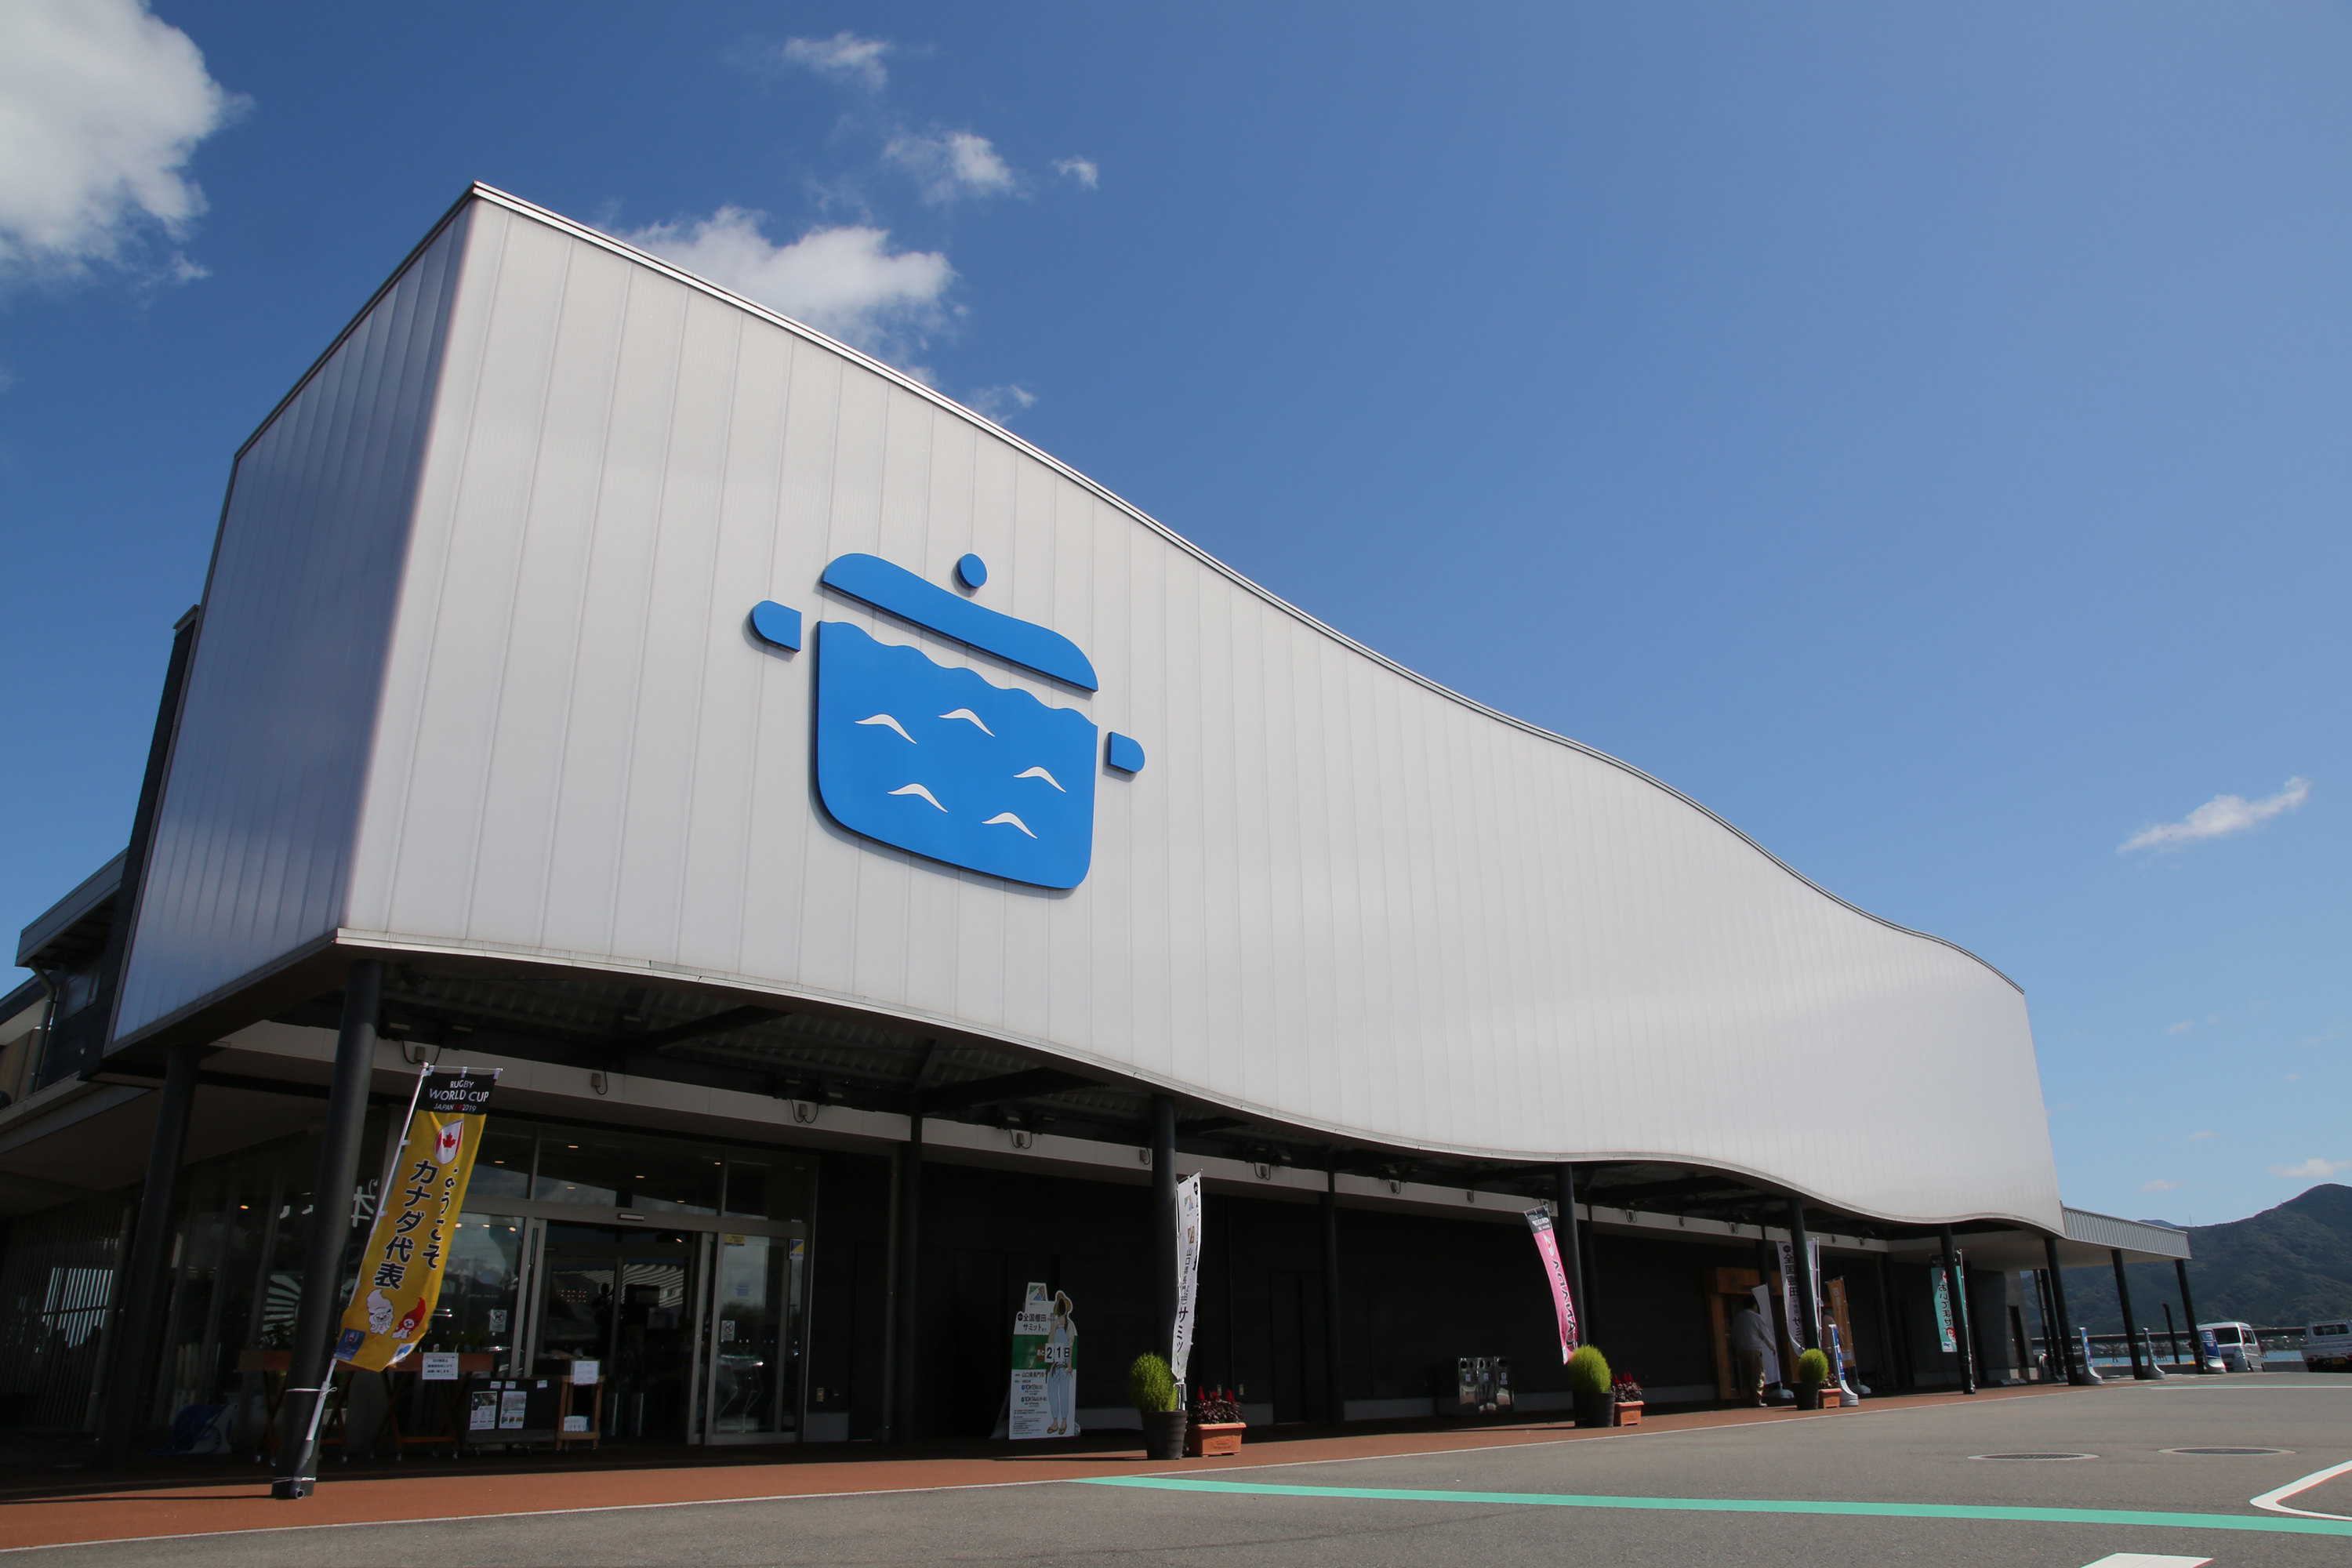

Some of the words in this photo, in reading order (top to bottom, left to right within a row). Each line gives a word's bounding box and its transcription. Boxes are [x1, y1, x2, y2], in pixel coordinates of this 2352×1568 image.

[450, 1080, 474, 1088] RUGBY
[430, 1088, 466, 1101] WORLD
[468, 1091, 489, 1102] CUP
[373, 1159, 439, 1290] カナダ代表
